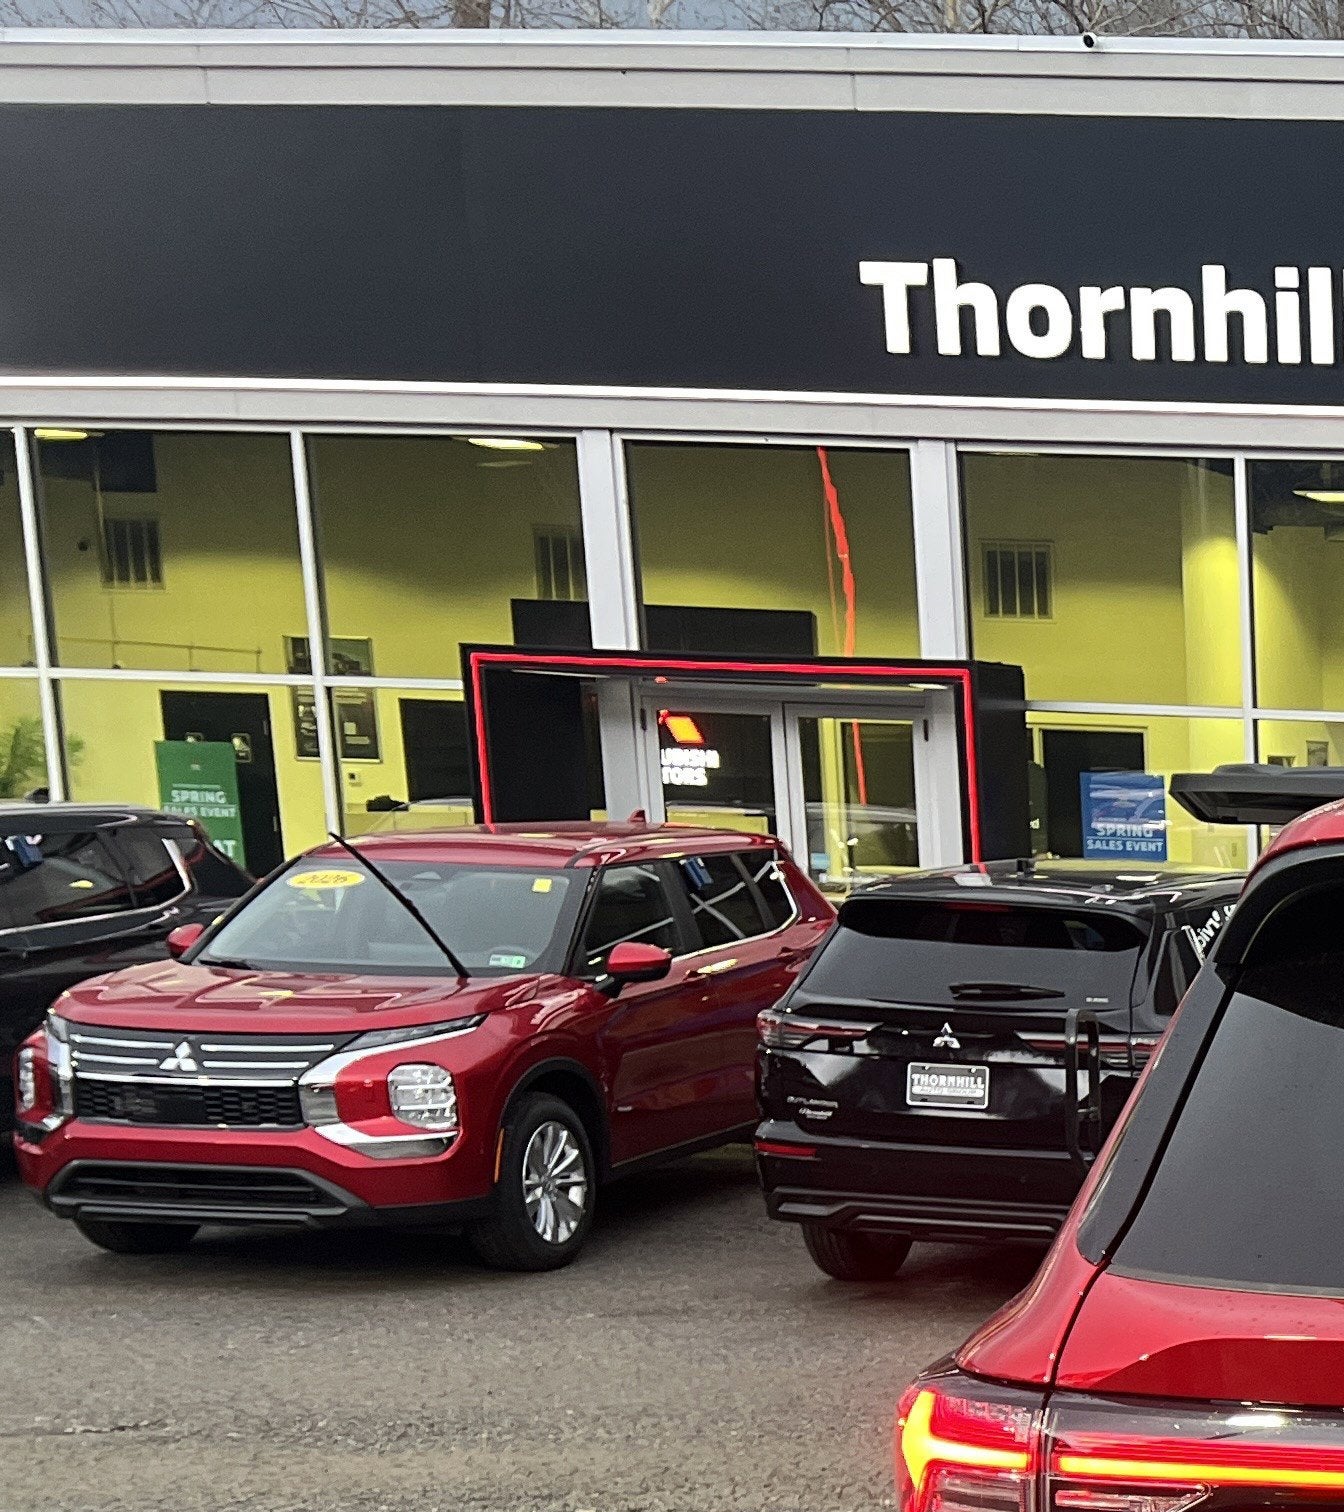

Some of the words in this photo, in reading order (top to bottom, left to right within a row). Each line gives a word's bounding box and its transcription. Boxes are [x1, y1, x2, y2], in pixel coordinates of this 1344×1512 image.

[171, 789, 227, 804] SPRING
[1096, 822, 1154, 838] SPRING
[1086, 839, 1124, 851] SALES
[1125, 840, 1164, 852] EVENT
[911, 1073, 985, 1090] THORNHILL
